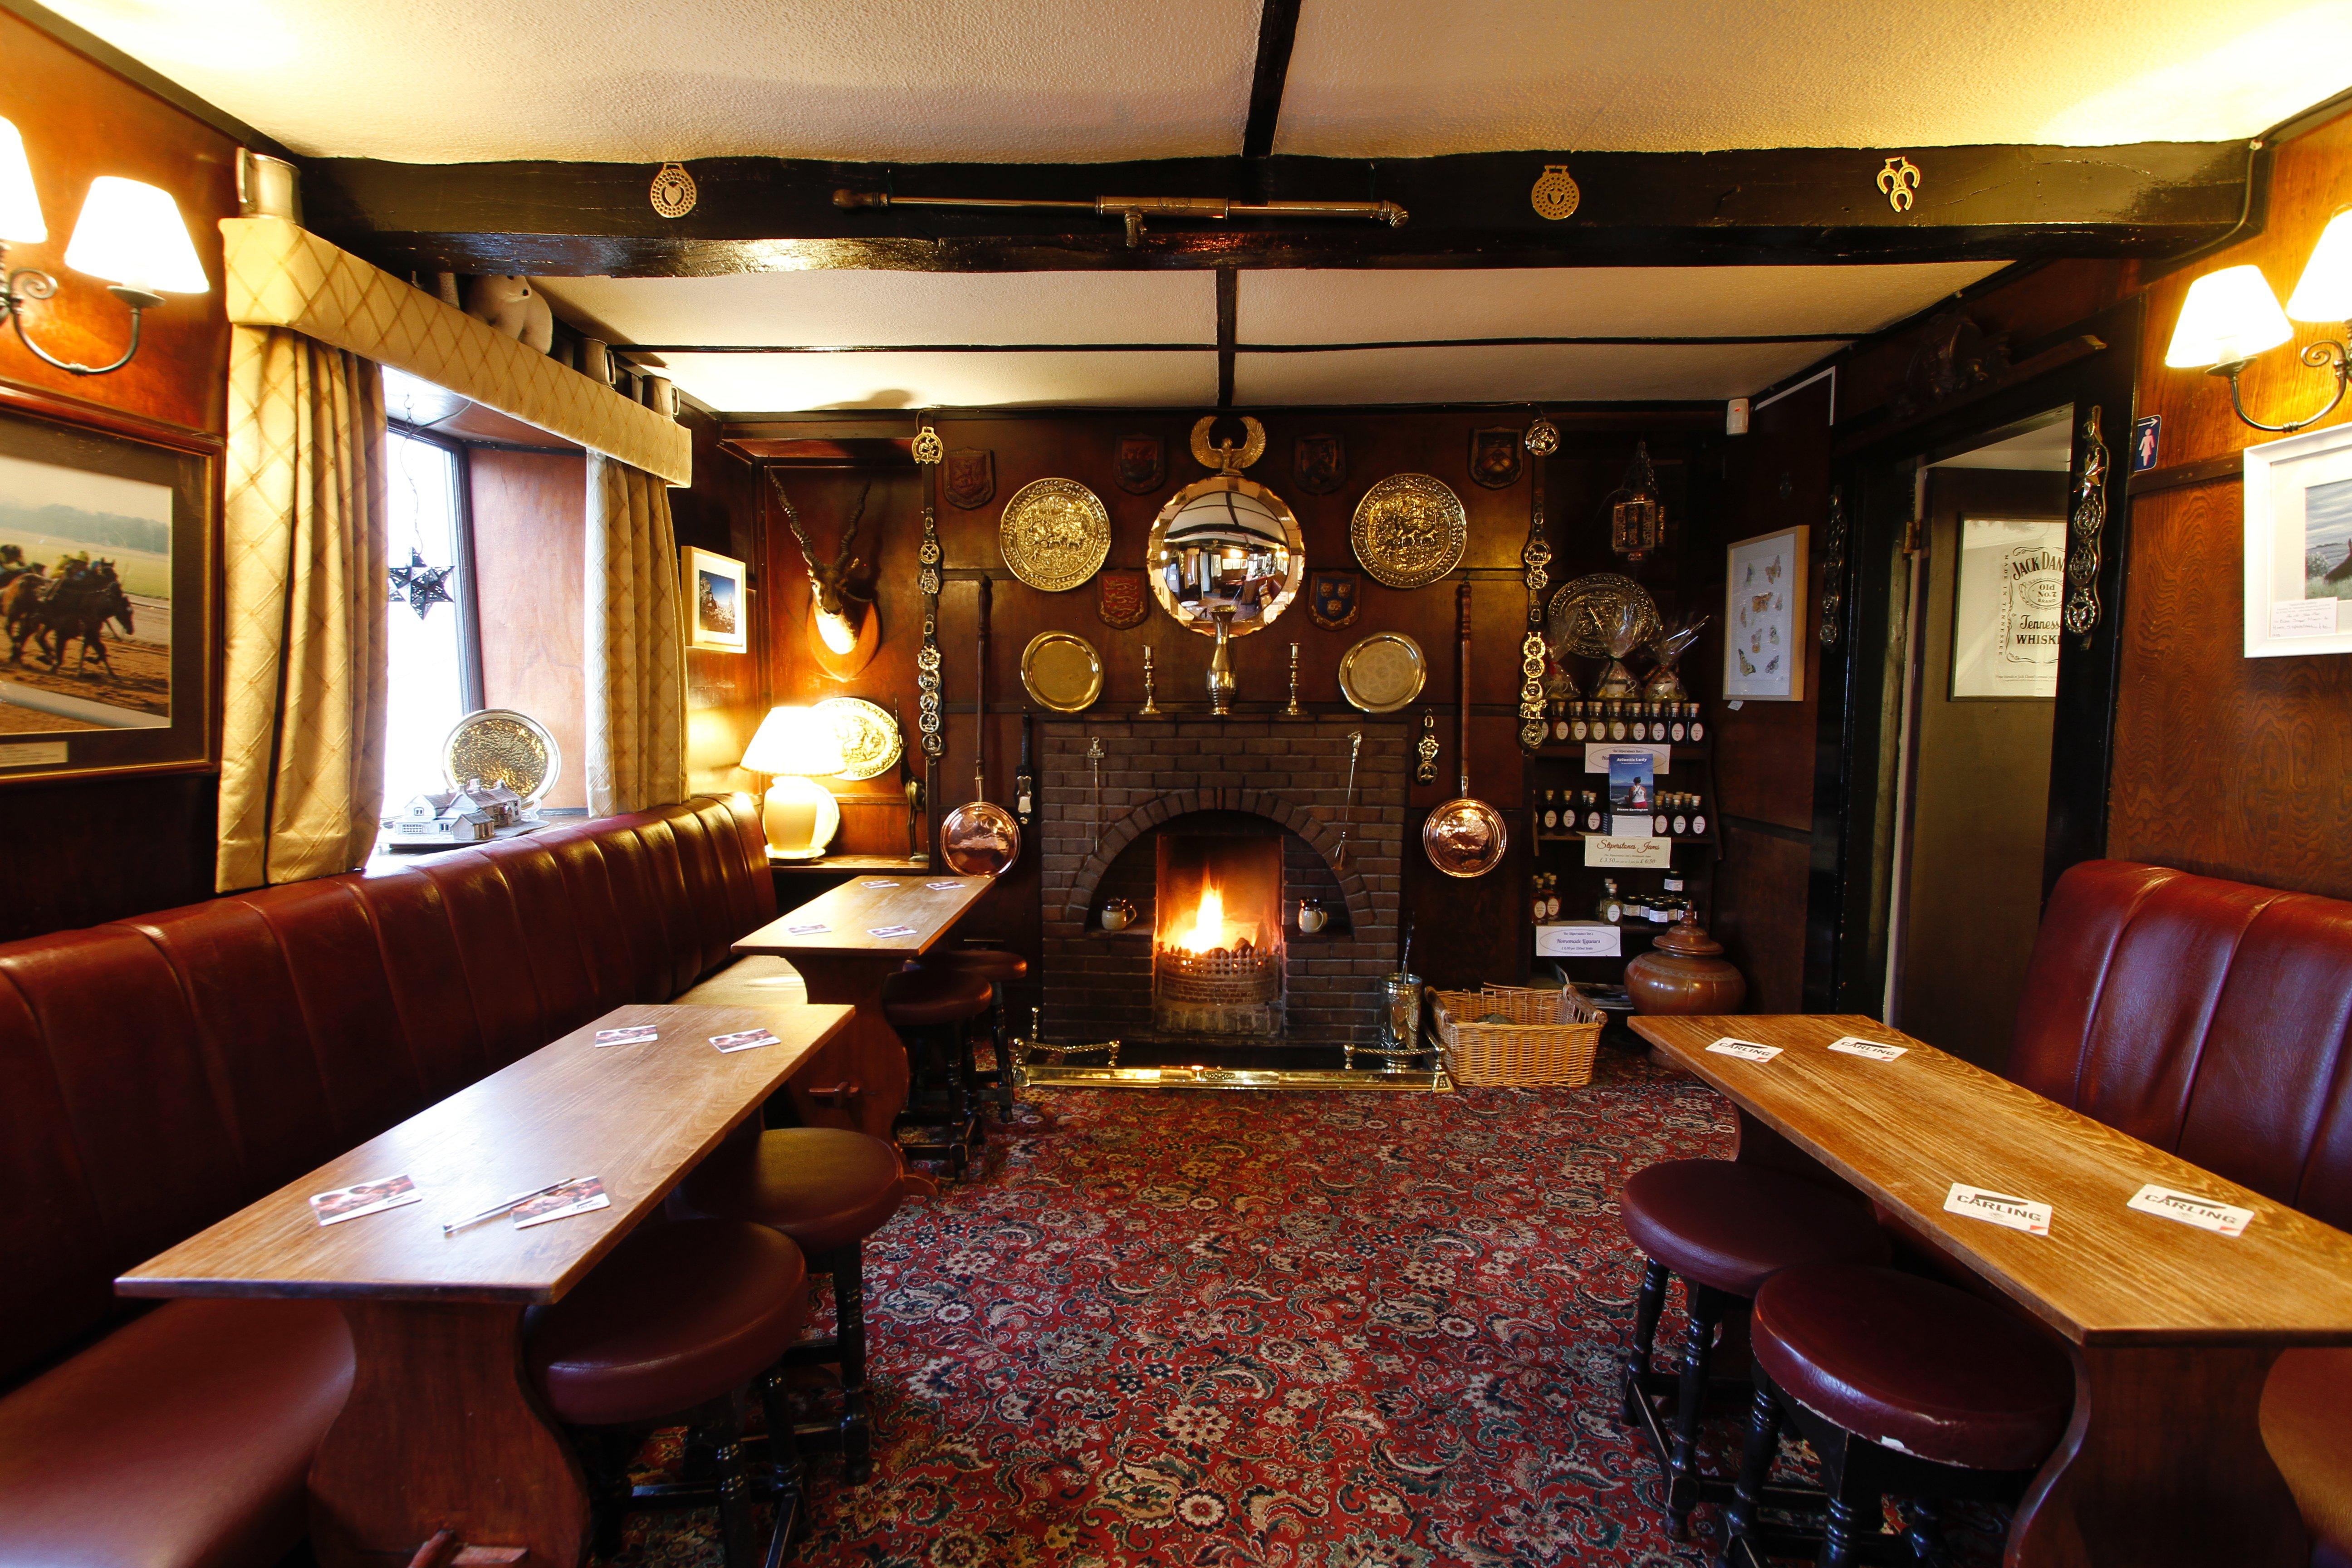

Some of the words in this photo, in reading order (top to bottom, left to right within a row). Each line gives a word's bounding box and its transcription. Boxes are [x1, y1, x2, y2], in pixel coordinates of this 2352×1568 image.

[2012, 556, 2041, 581] JACK
[2042, 551, 2066, 573] DAN
[2003, 586, 2007, 596] IN
[1998, 602, 2007, 656] TENNESSEE
[2019, 614, 2060, 630] Tenness
[1597, 839, 1636, 851] Stiperstones
[1637, 840, 1660, 853] Jams
[1719, 1043, 1771, 1056] CARLING
[1841, 1042, 1896, 1056] CARLING
[1957, 1195, 2042, 1222] CARLING
[2145, 1194, 2237, 1224] CARLING
